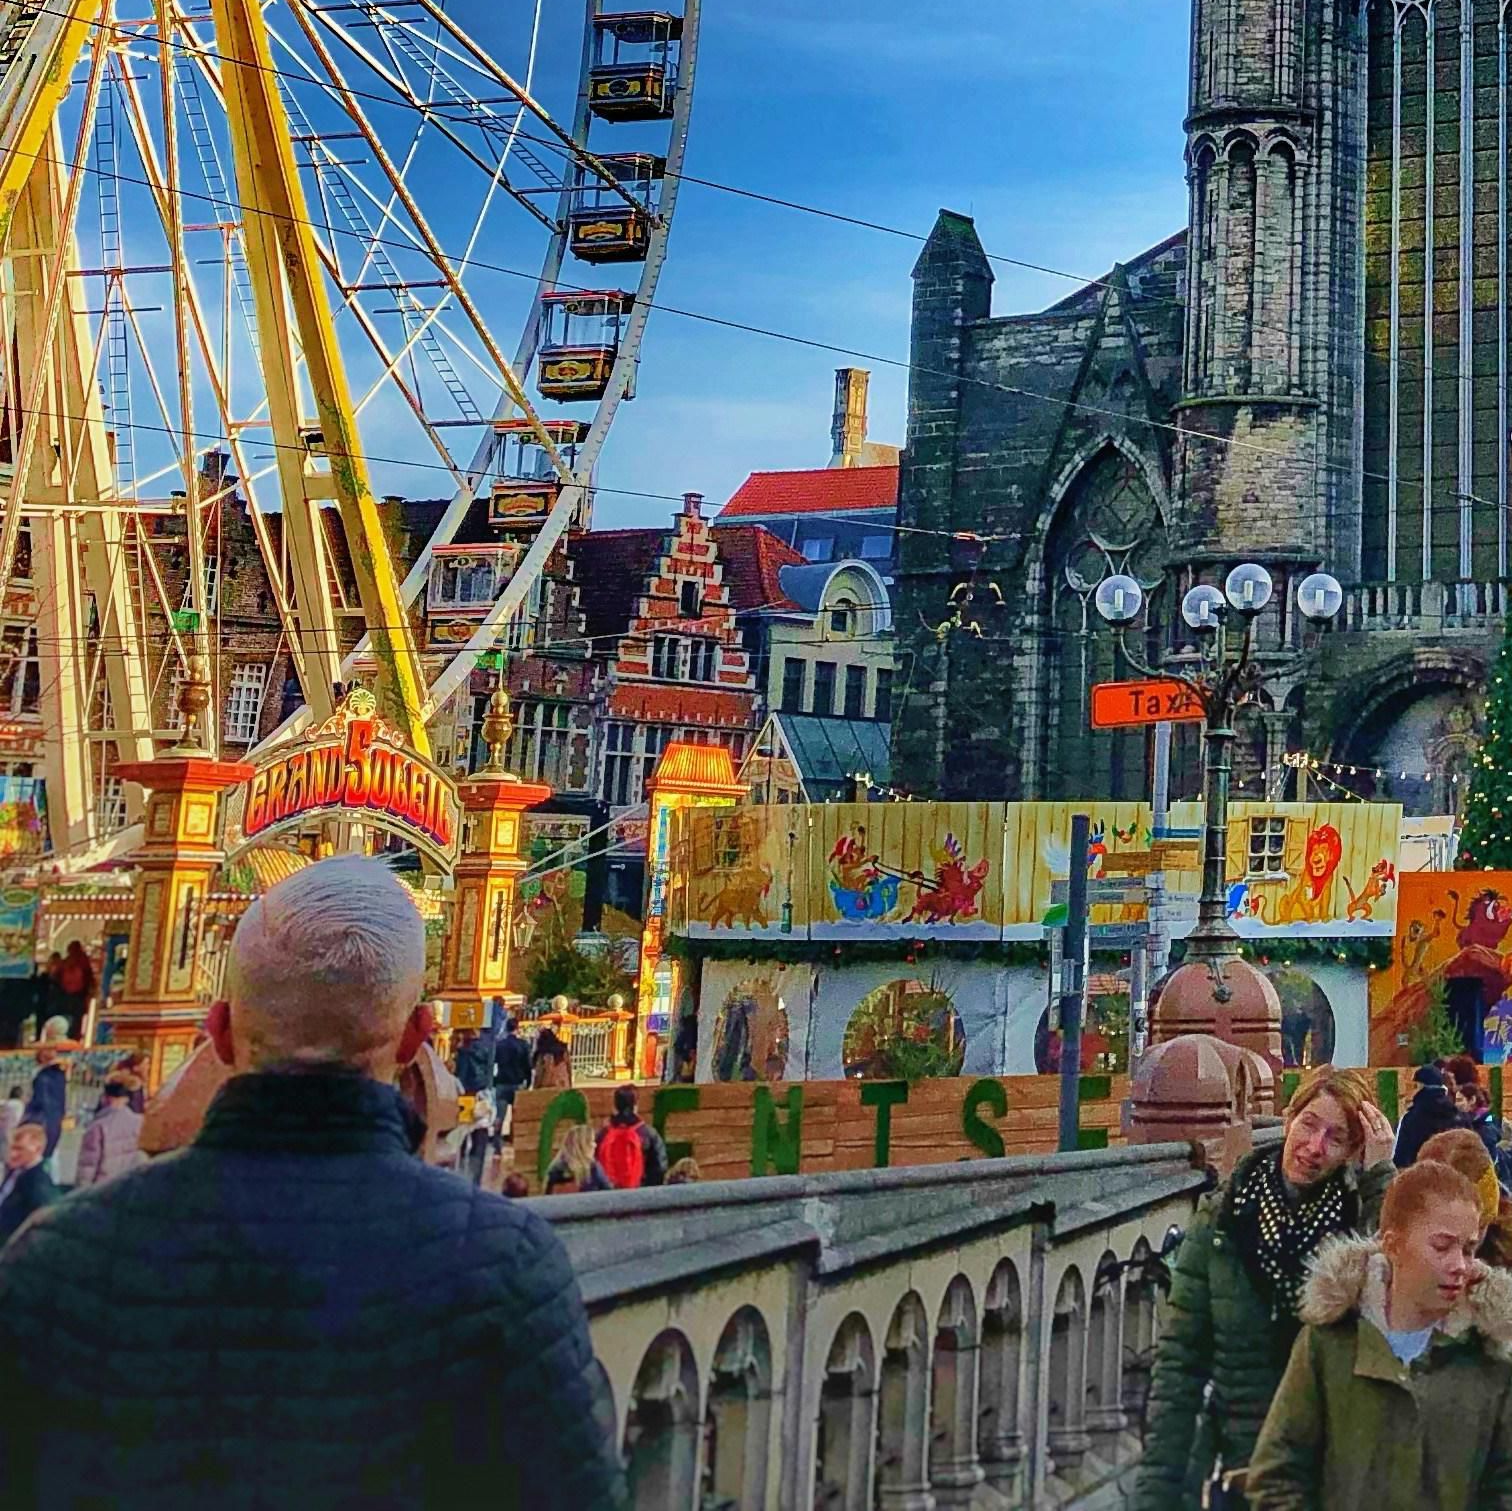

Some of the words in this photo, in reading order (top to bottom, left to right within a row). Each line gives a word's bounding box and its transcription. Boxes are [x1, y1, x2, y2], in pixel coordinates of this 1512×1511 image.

[1128, 689, 1192, 716] Taxi
[245, 745, 345, 835] GRAND
[343, 720, 451, 846] SOLEIL
